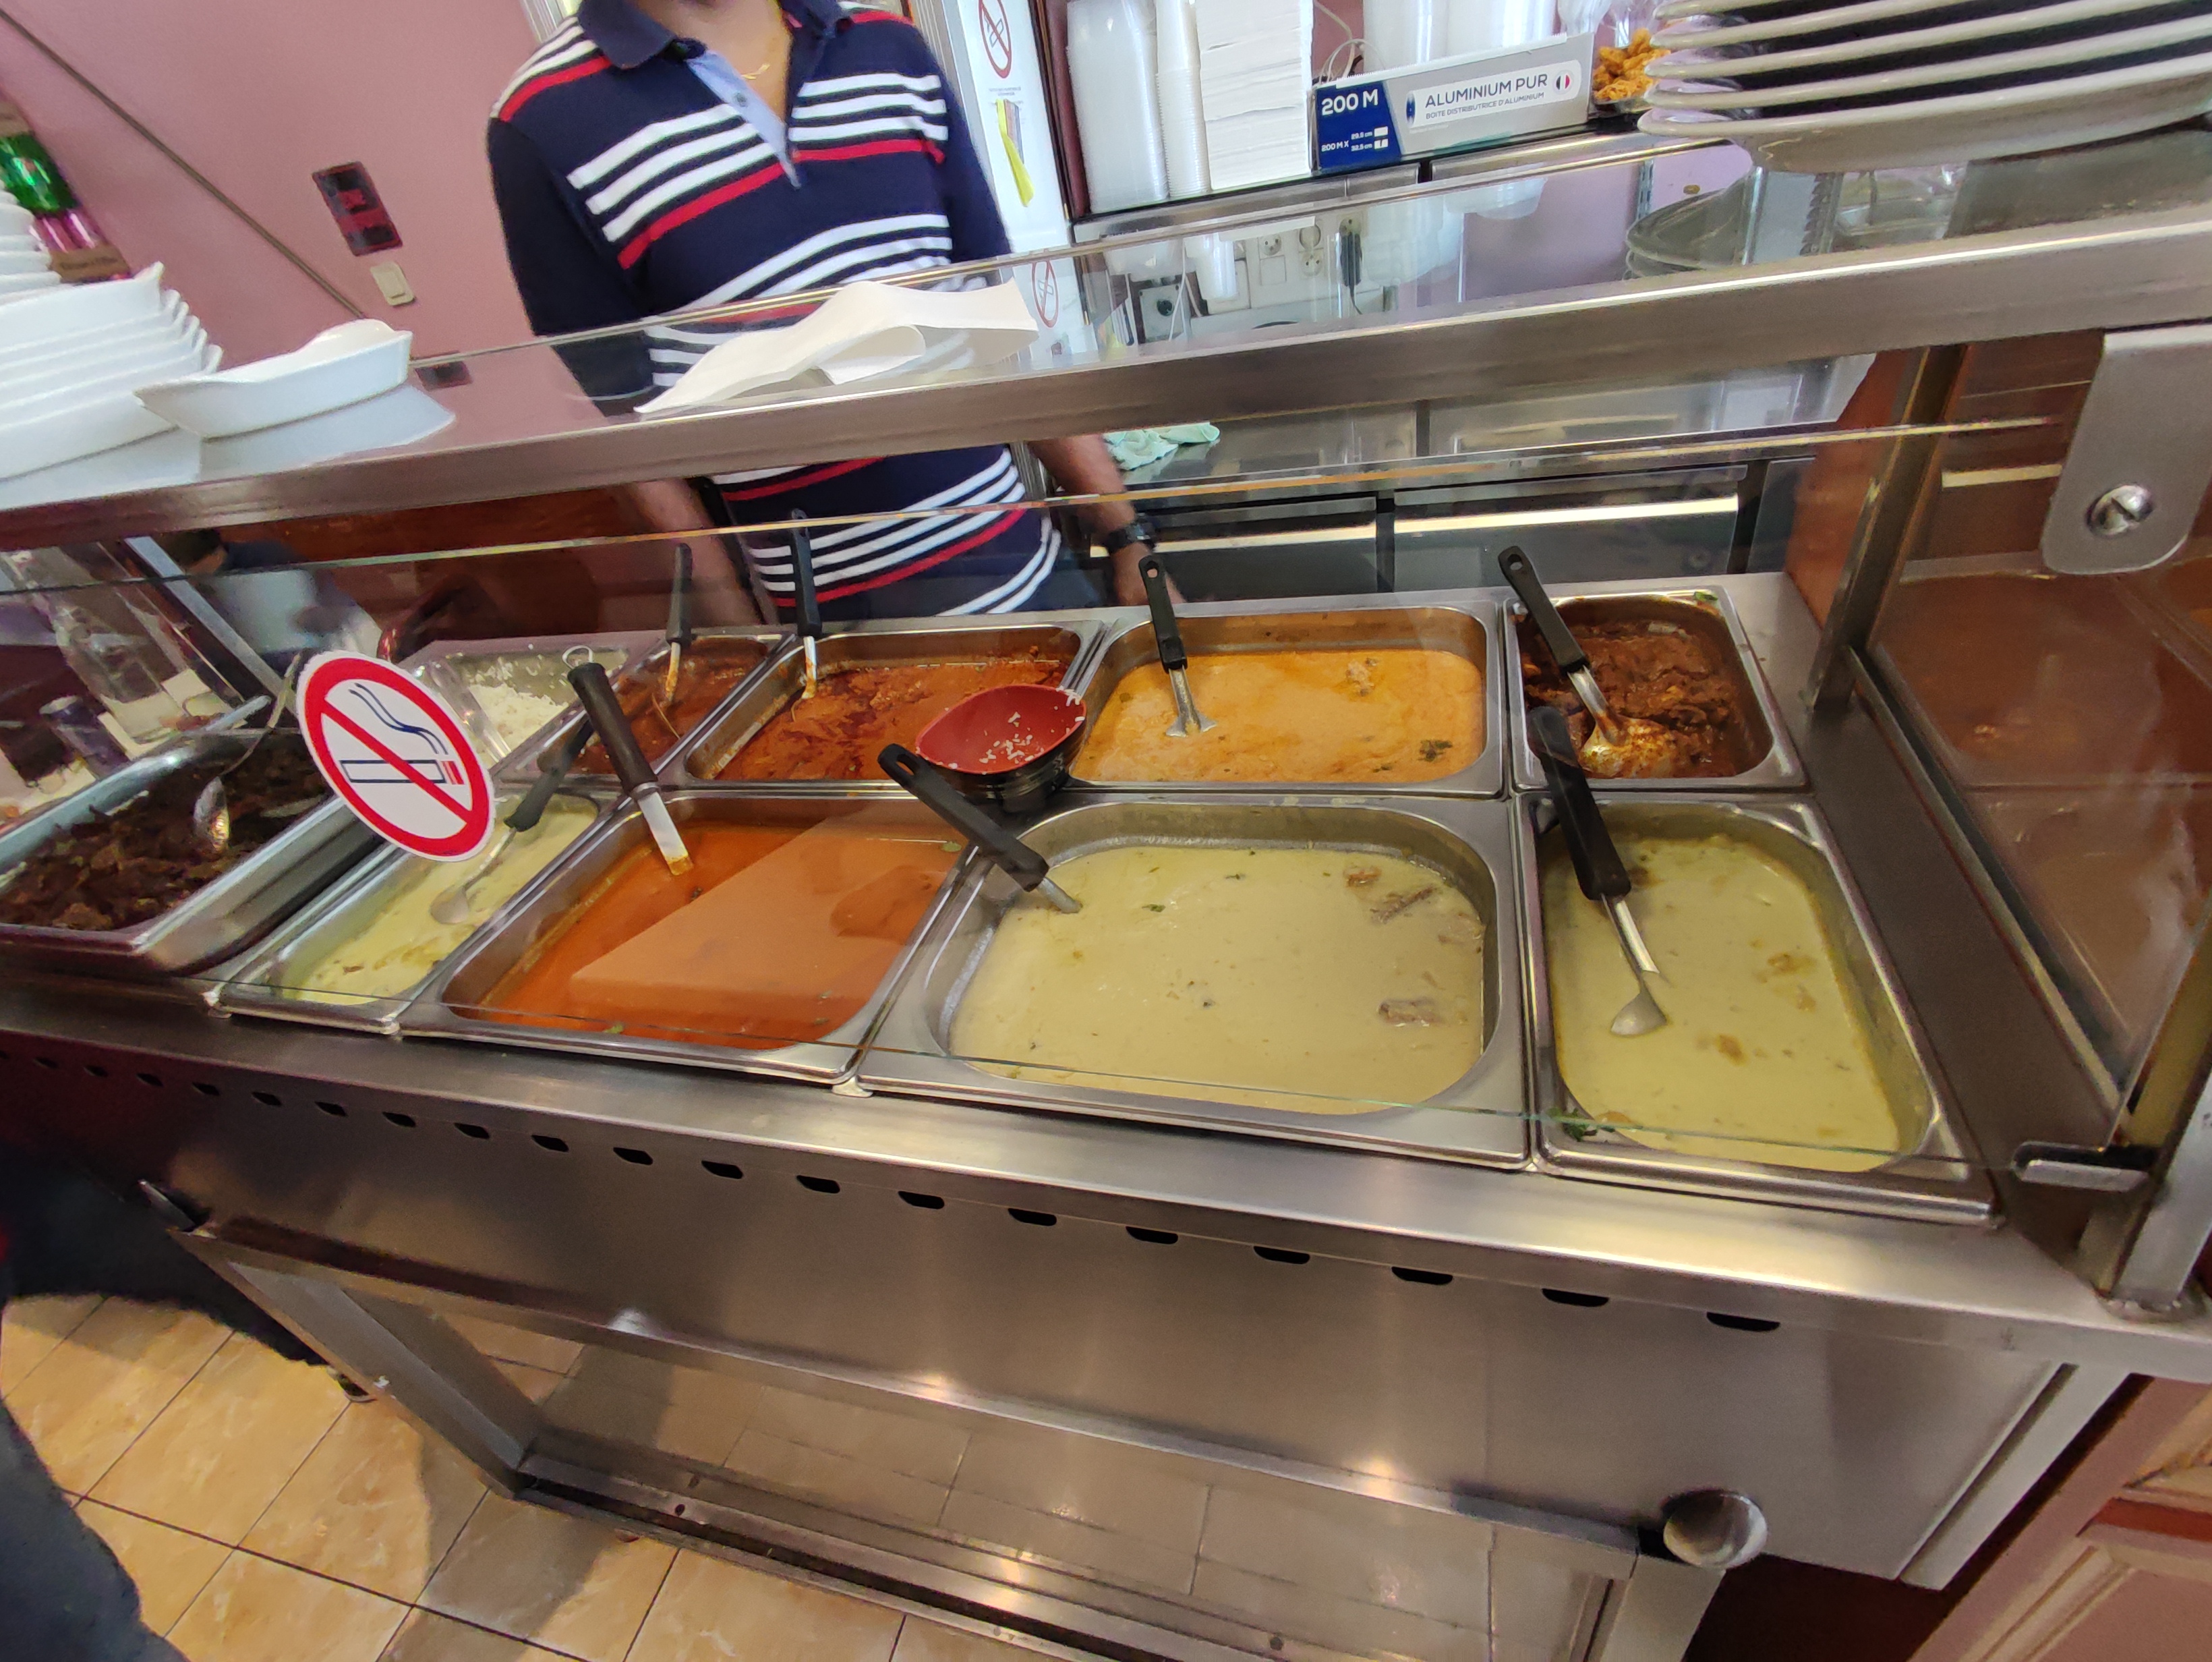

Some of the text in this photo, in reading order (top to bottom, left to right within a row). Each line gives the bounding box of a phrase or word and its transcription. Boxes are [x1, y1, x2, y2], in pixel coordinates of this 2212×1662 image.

[1322, 88, 1378, 115] 200 M
[1425, 74, 1548, 108] ALUMINIUM PUR
[1447, 100, 1496, 115] DISTRIBUTRICE
[1498, 92, 1544, 107] D'ALUMINIUM
[1321, 143, 1335, 152] 200
[1337, 141, 1343, 149] M
